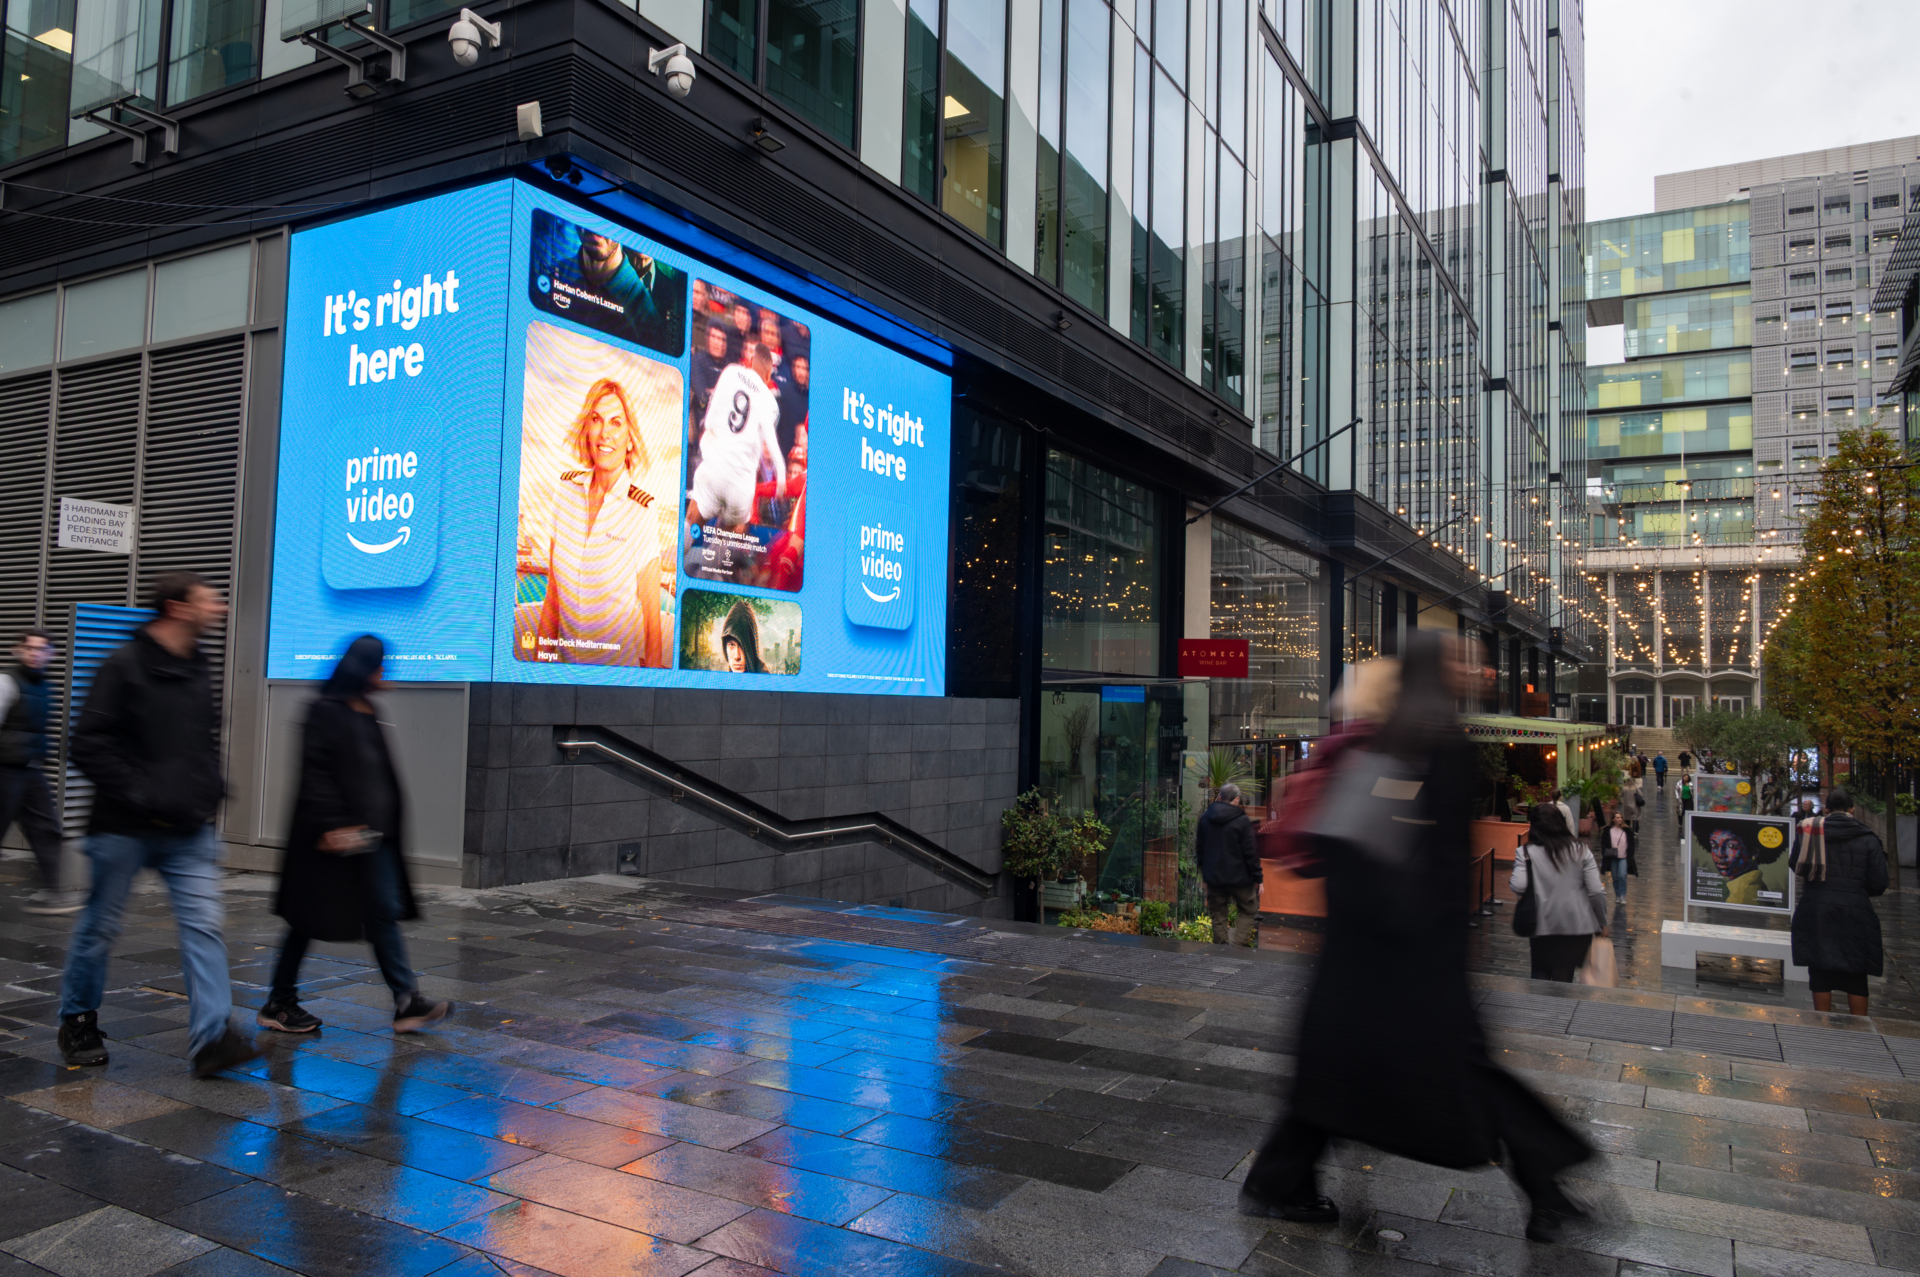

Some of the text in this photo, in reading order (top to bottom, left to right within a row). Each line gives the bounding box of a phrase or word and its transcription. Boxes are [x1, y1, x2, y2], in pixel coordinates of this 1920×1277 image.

[323, 269, 460, 337] It's right
[553, 279, 625, 314] Harlan Coben's Lazarus
[553, 292, 571, 305] prime
[348, 342, 425, 387] here
[728, 389, 750, 434] 9
[843, 386, 925, 448] It's right
[861, 436, 907, 481] here
[345, 446, 418, 492] prime
[63, 503, 129, 519] 3 HARDMAN ST
[346, 487, 415, 523] video
[66, 514, 126, 528] LOADING BAY
[67, 524, 124, 538] PEDESTRIAN
[70, 534, 119, 547] ENTRANCE
[703, 525, 760, 543] UEFA Champions League
[860, 522, 904, 551] prime
[702, 548, 716, 557] prime
[703, 534, 767, 553] Tuesday's unmissable match
[861, 550, 902, 582] video
[538, 636, 621, 650] Below Deck Mediterranean
[537, 651, 558, 662] Hayu
[1182, 650, 1245, 658] ATOMECA
